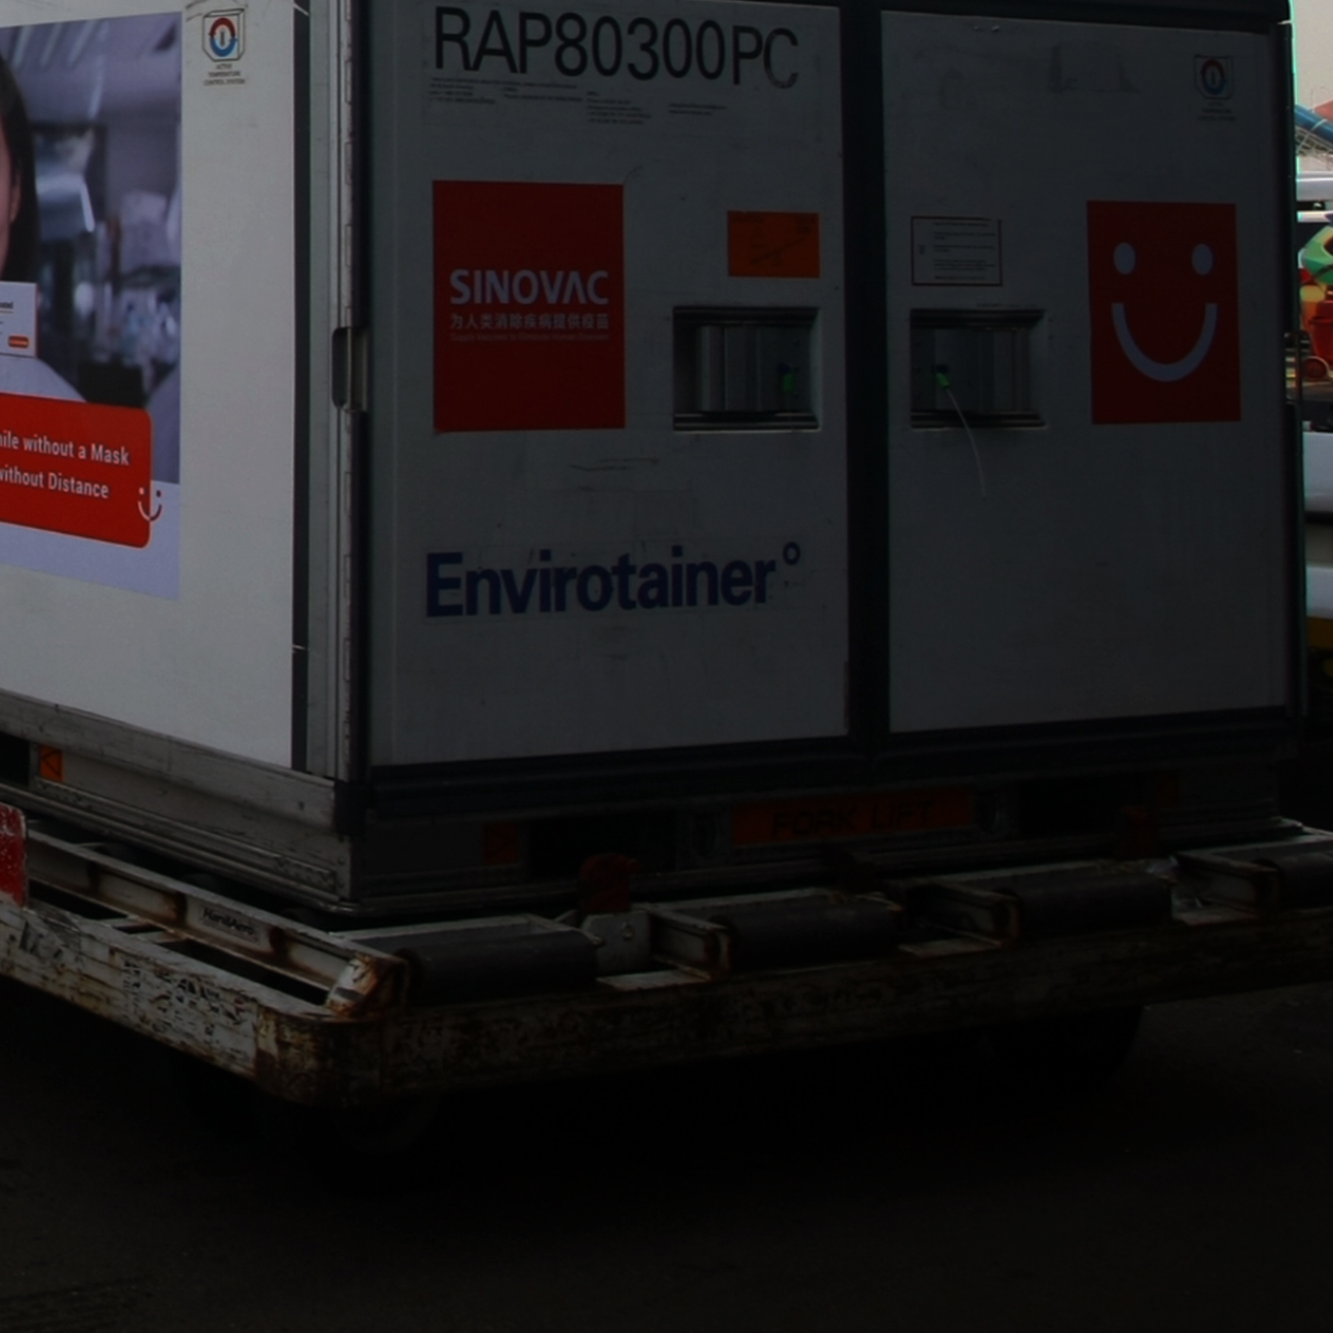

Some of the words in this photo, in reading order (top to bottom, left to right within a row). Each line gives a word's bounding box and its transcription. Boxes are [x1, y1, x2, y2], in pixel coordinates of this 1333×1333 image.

[434, 5, 800, 90] RAP80300PC
[449, 269, 610, 306] SINOVAC
[23, 433, 75, 458] without
[77, 446, 87, 460] a
[91, 443, 131, 466] Mask
[48, 472, 110, 500] Distance
[771, 805, 857, 841] FORK
[870, 798, 935, 832] LIFT
